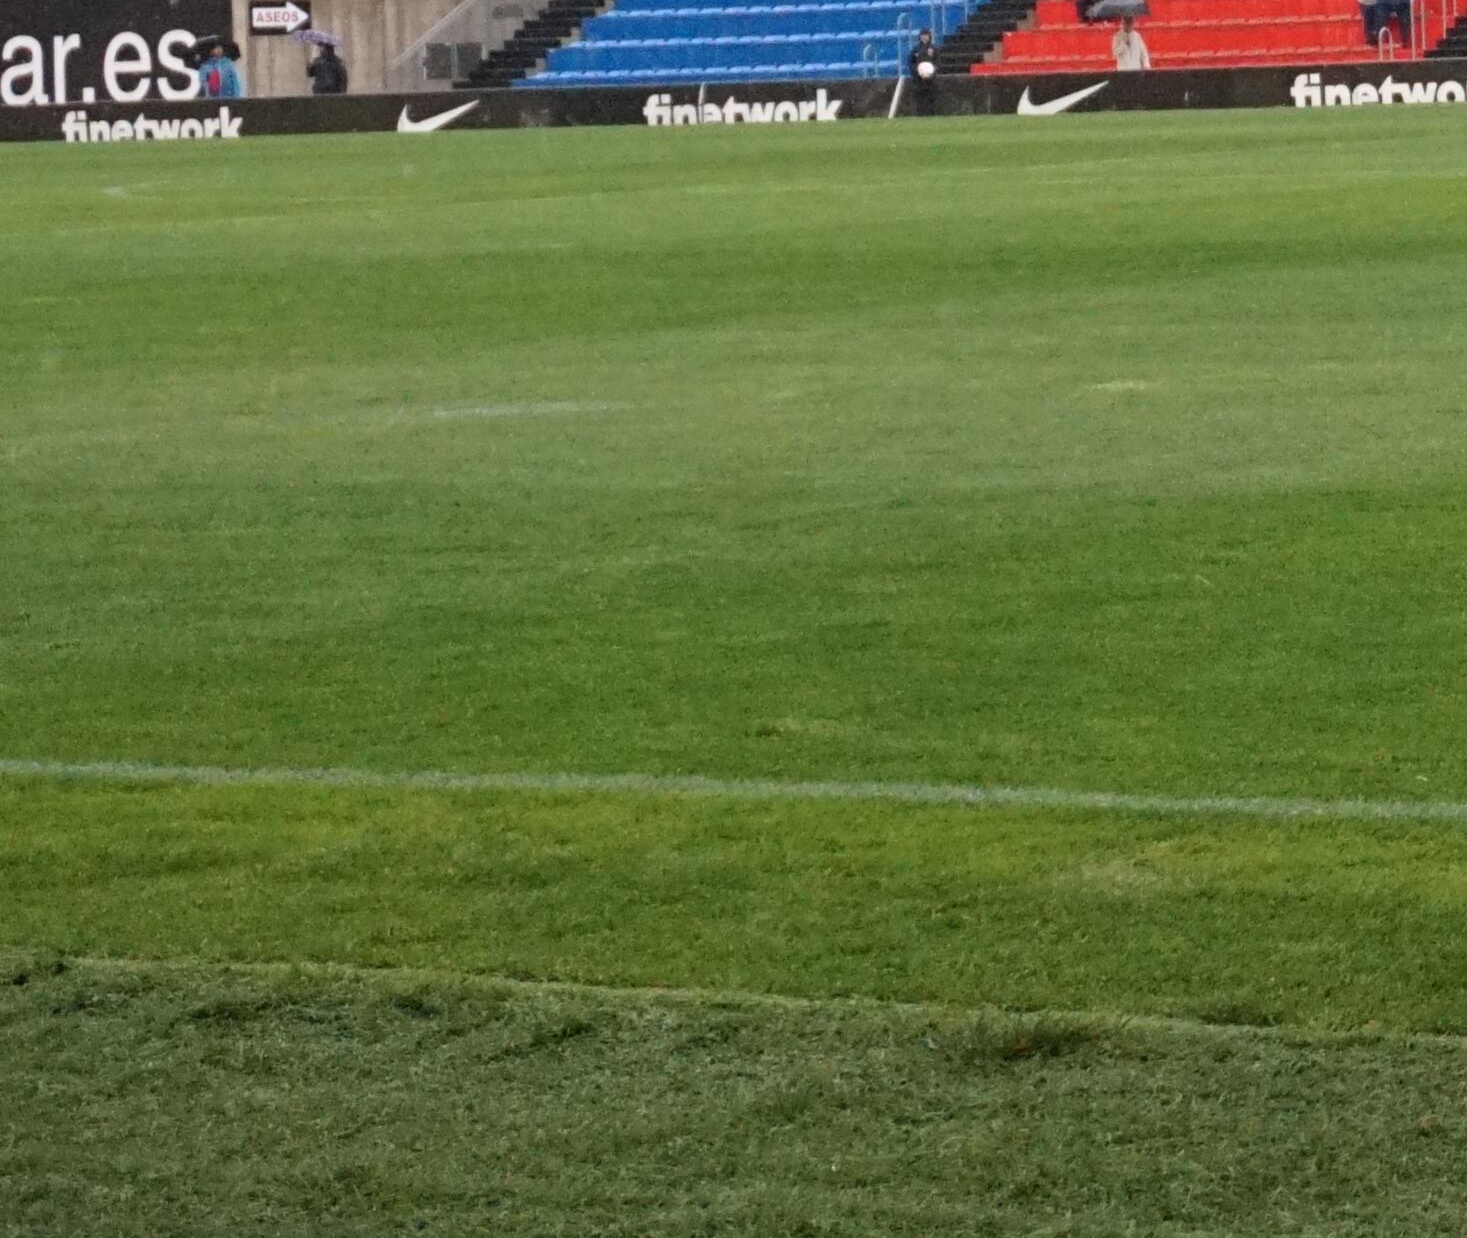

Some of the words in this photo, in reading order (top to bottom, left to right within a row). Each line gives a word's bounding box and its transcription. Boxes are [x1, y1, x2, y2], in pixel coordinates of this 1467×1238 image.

[256, 11, 299, 23] ASEOS
[0, 29, 201, 106] ar.es
[61, 106, 243, 143] finetwork
[643, 88, 843, 126] finetwork
